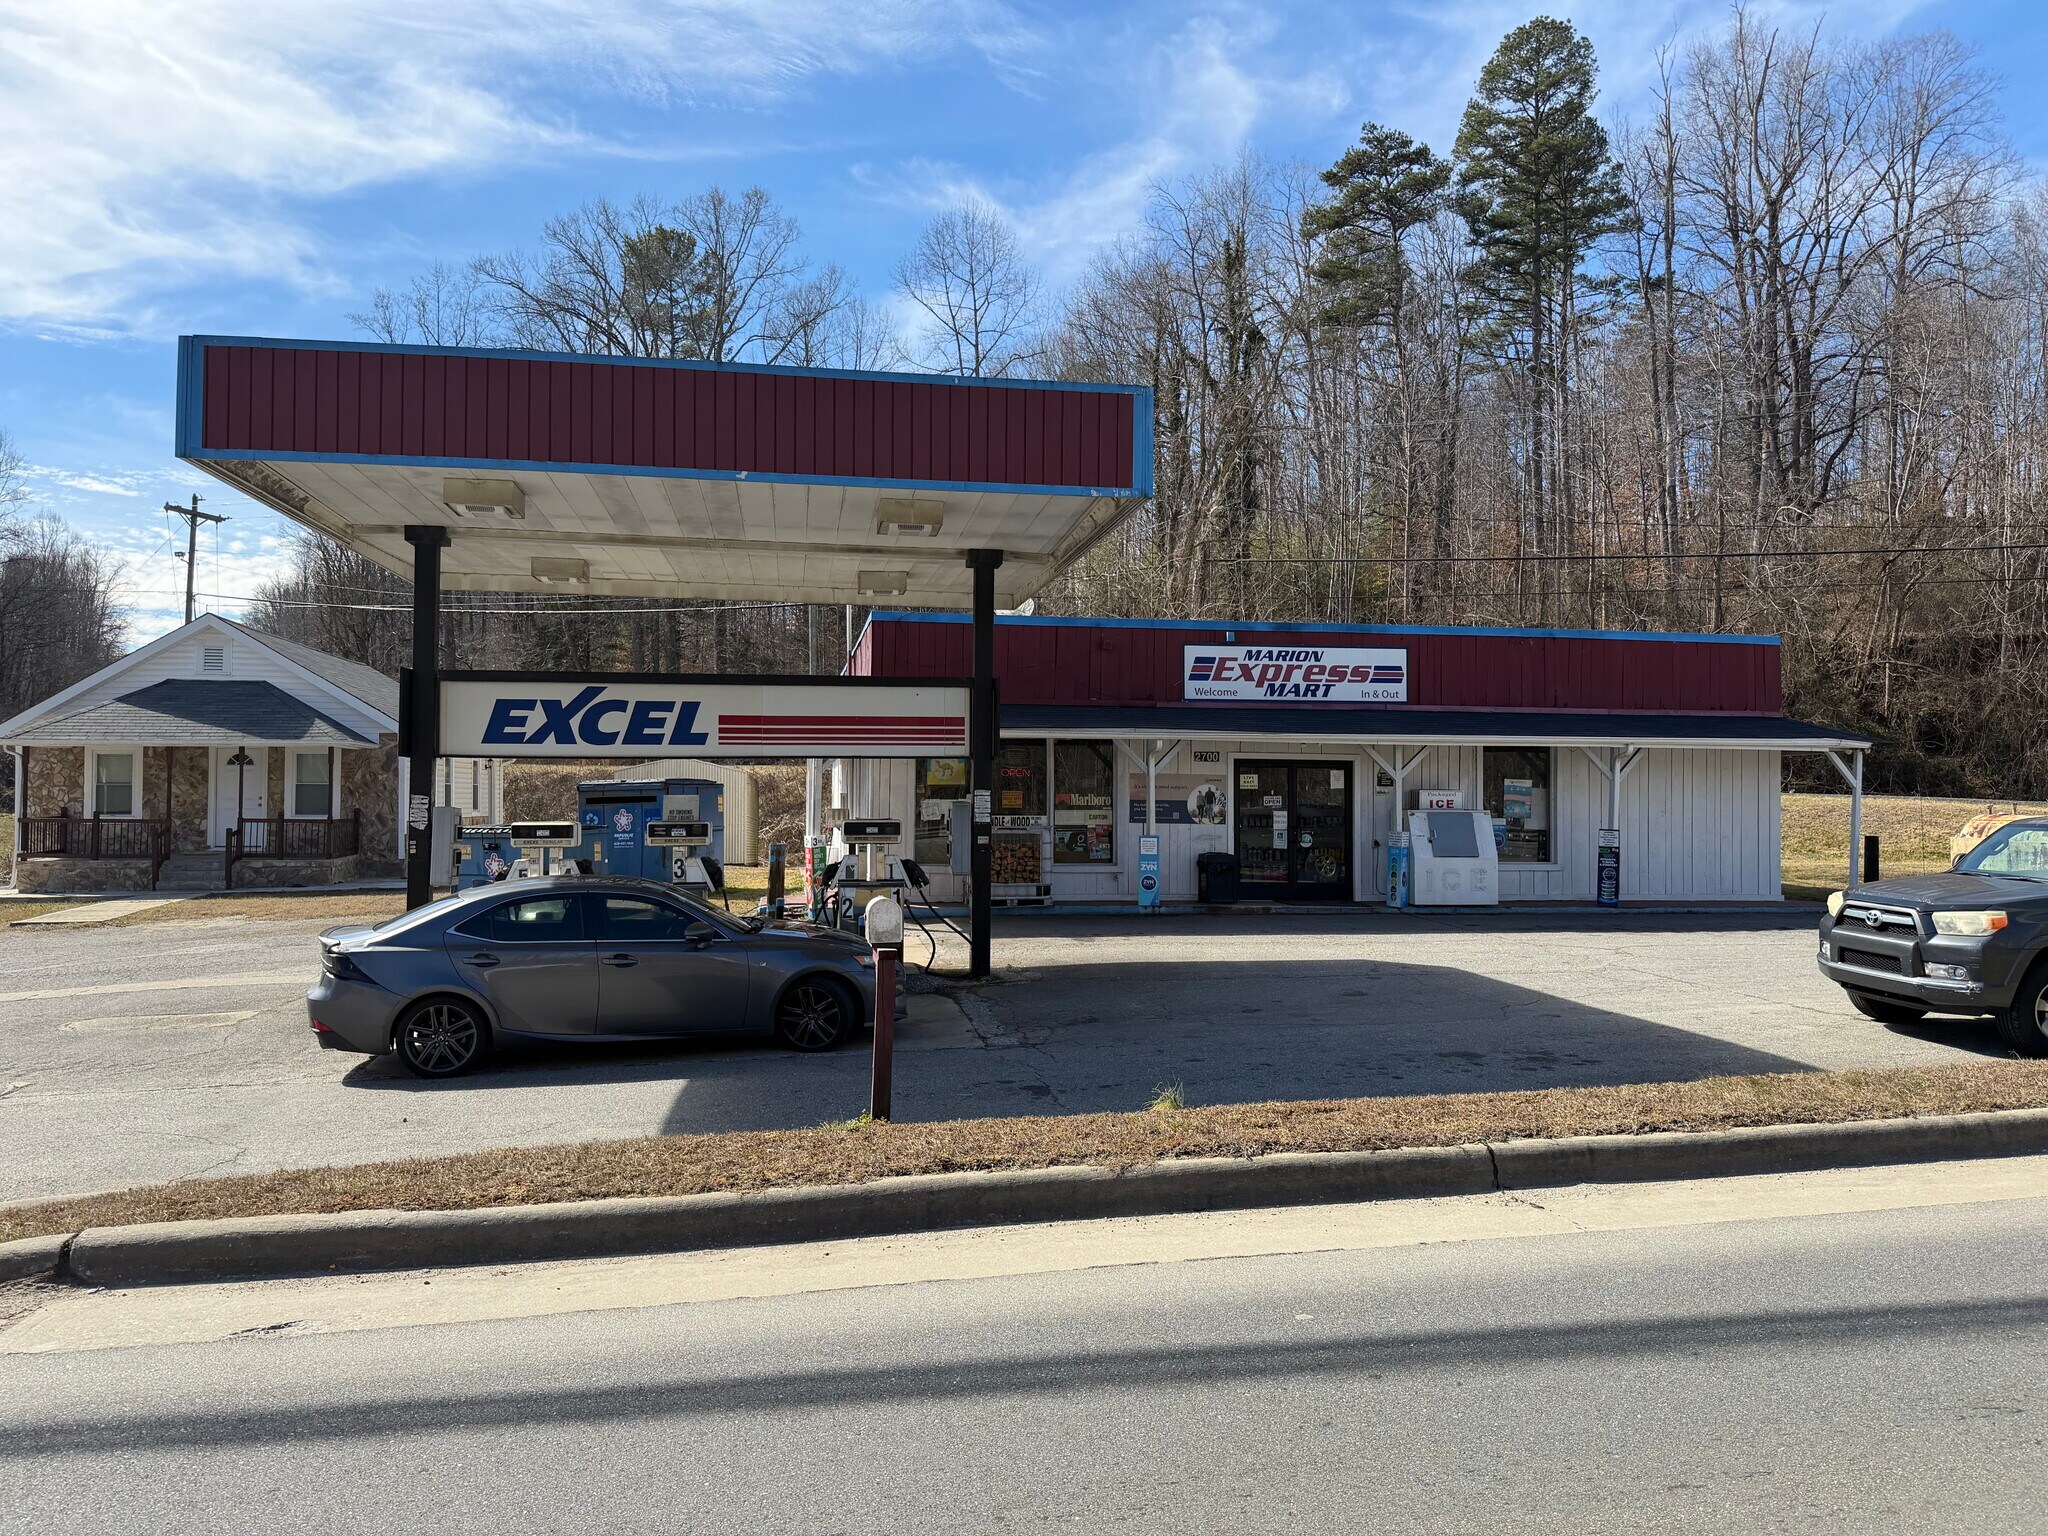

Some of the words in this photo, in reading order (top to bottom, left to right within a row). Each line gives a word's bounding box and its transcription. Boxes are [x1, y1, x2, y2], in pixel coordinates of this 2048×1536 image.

[1243, 650, 1324, 662] MARION
[1211, 657, 1372, 688] Express
[1194, 687, 1239, 697] Welcome
[1264, 683, 1336, 698] MART
[1361, 690, 1371, 698] In
[1372, 690, 1381, 699] &
[1382, 690, 1400, 699] Out
[480, 686, 710, 746] EXCEL
[1194, 752, 1219, 762] 2700
[1001, 768, 1031, 777] OPEN
[1070, 793, 1111, 806] Marlboro
[1429, 800, 1454, 809] ICE
[1010, 817, 1030, 827] WOOD
[812, 838, 818, 847] 3
[673, 858, 685, 879] 3
[889, 864, 894, 879] 1
[1140, 863, 1157, 871] ZYN
[1426, 868, 1488, 892] ICE
[842, 898, 853, 919] 2
